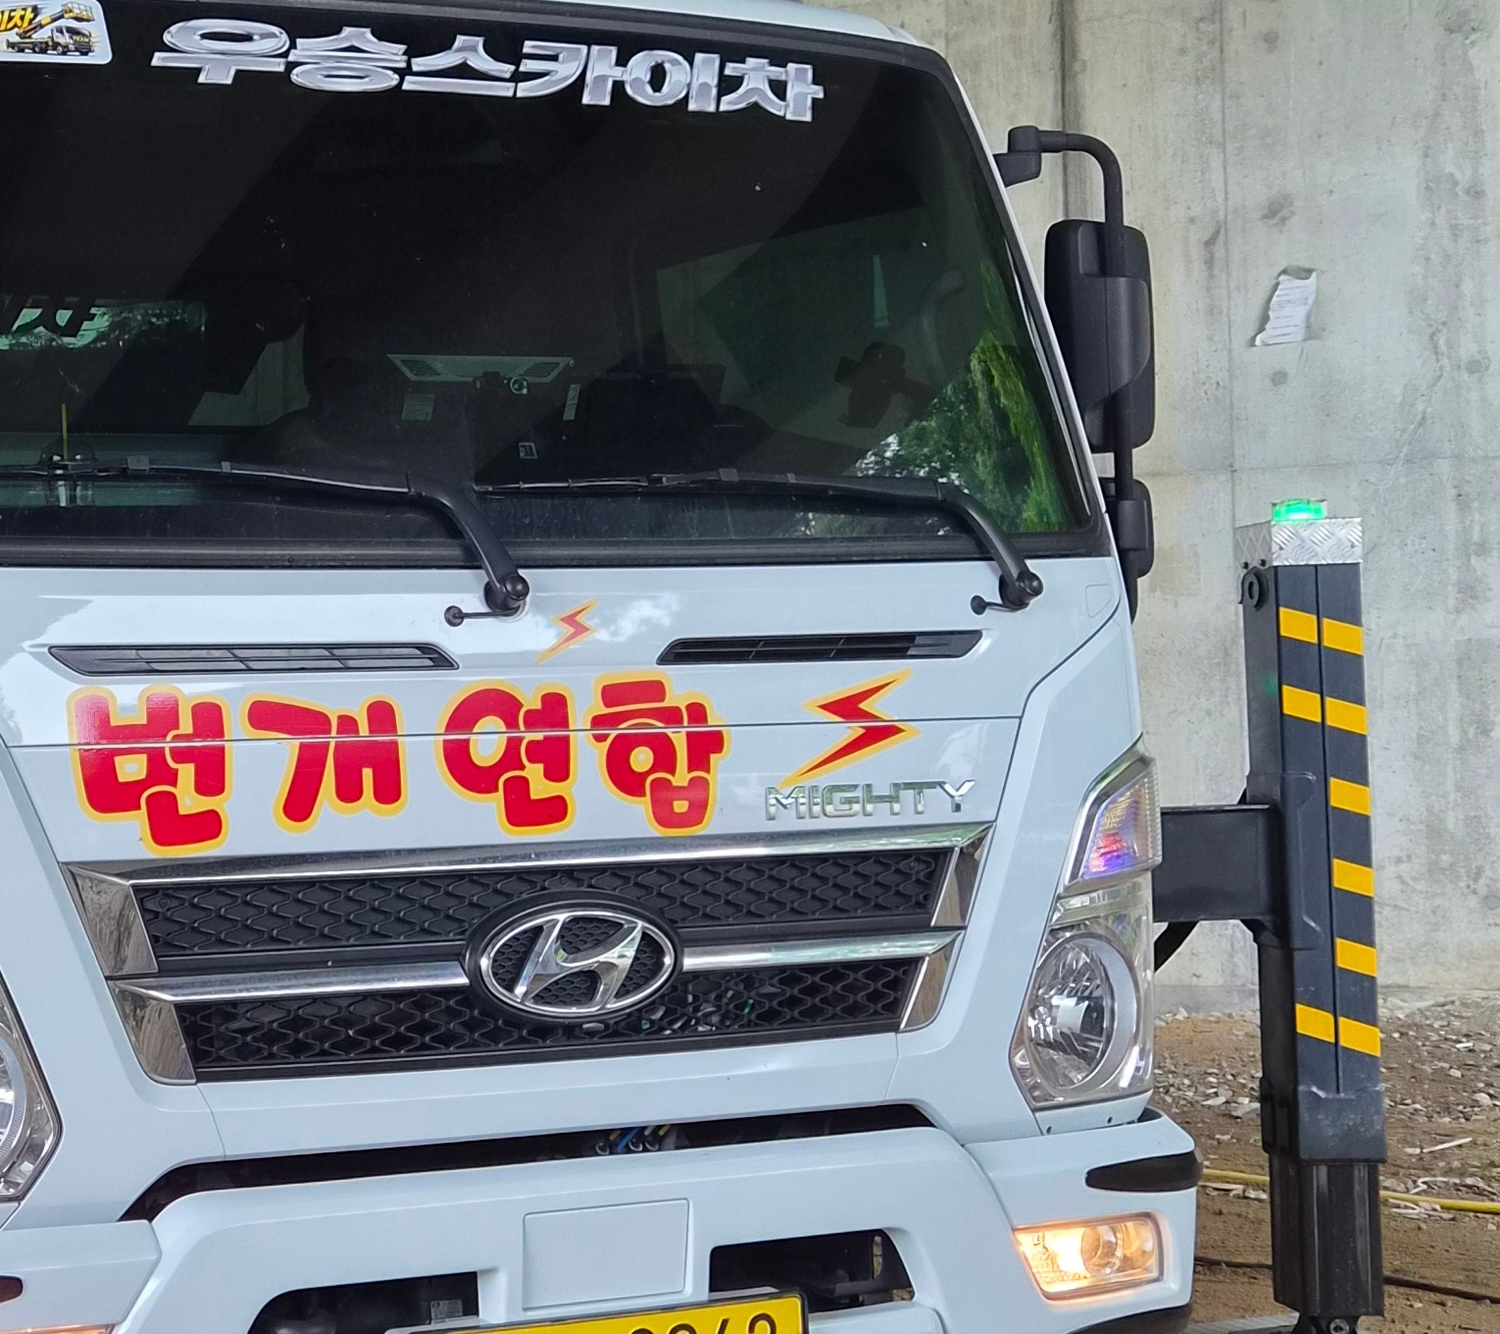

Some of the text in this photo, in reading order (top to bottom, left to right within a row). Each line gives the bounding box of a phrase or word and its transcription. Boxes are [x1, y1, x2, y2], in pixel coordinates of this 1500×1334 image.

[151, 16, 824, 123] 우승스카이차
[67, 671, 731, 857] 번개 연합
[764, 778, 976, 822] MIGHTY
